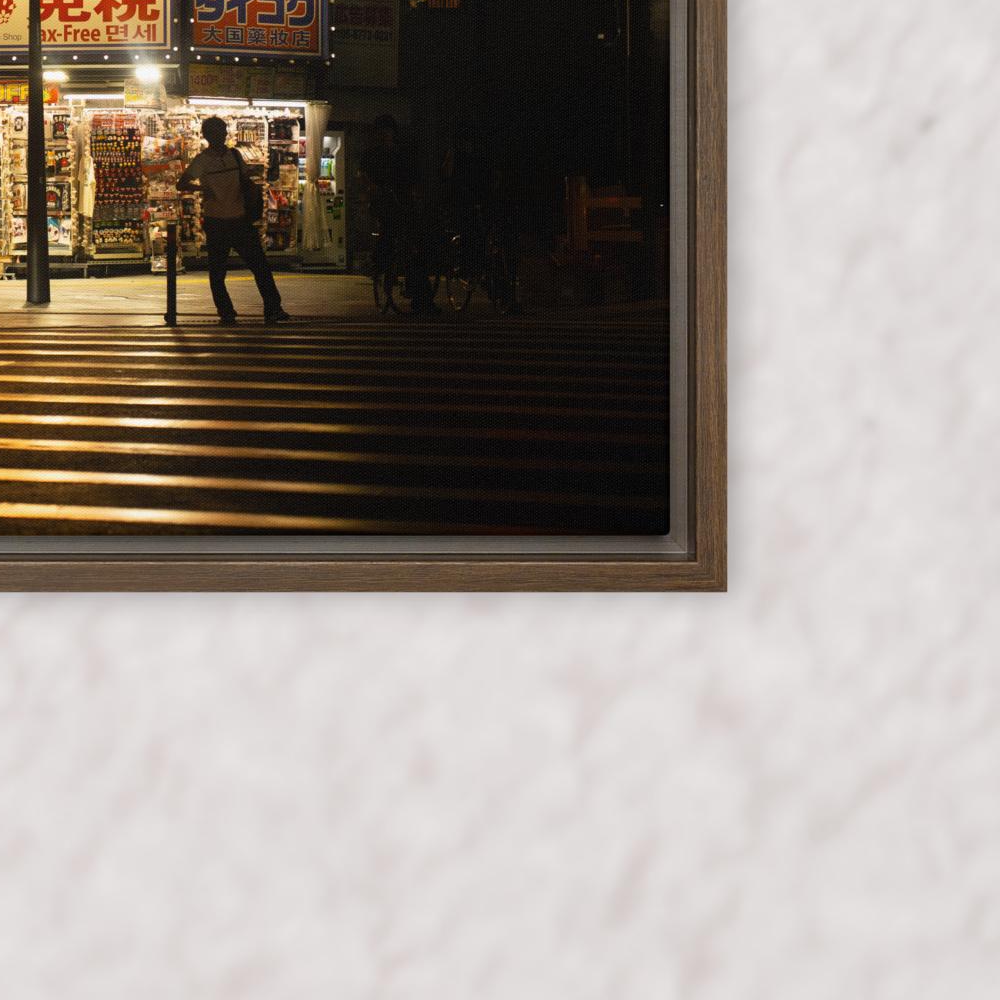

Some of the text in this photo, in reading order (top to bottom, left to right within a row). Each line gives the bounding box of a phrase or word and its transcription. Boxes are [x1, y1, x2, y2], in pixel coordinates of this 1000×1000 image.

[3, 33, 22, 42] Shop
[40, 24, 101, 42] ax-Free
[105, 24, 157, 42] 면세
